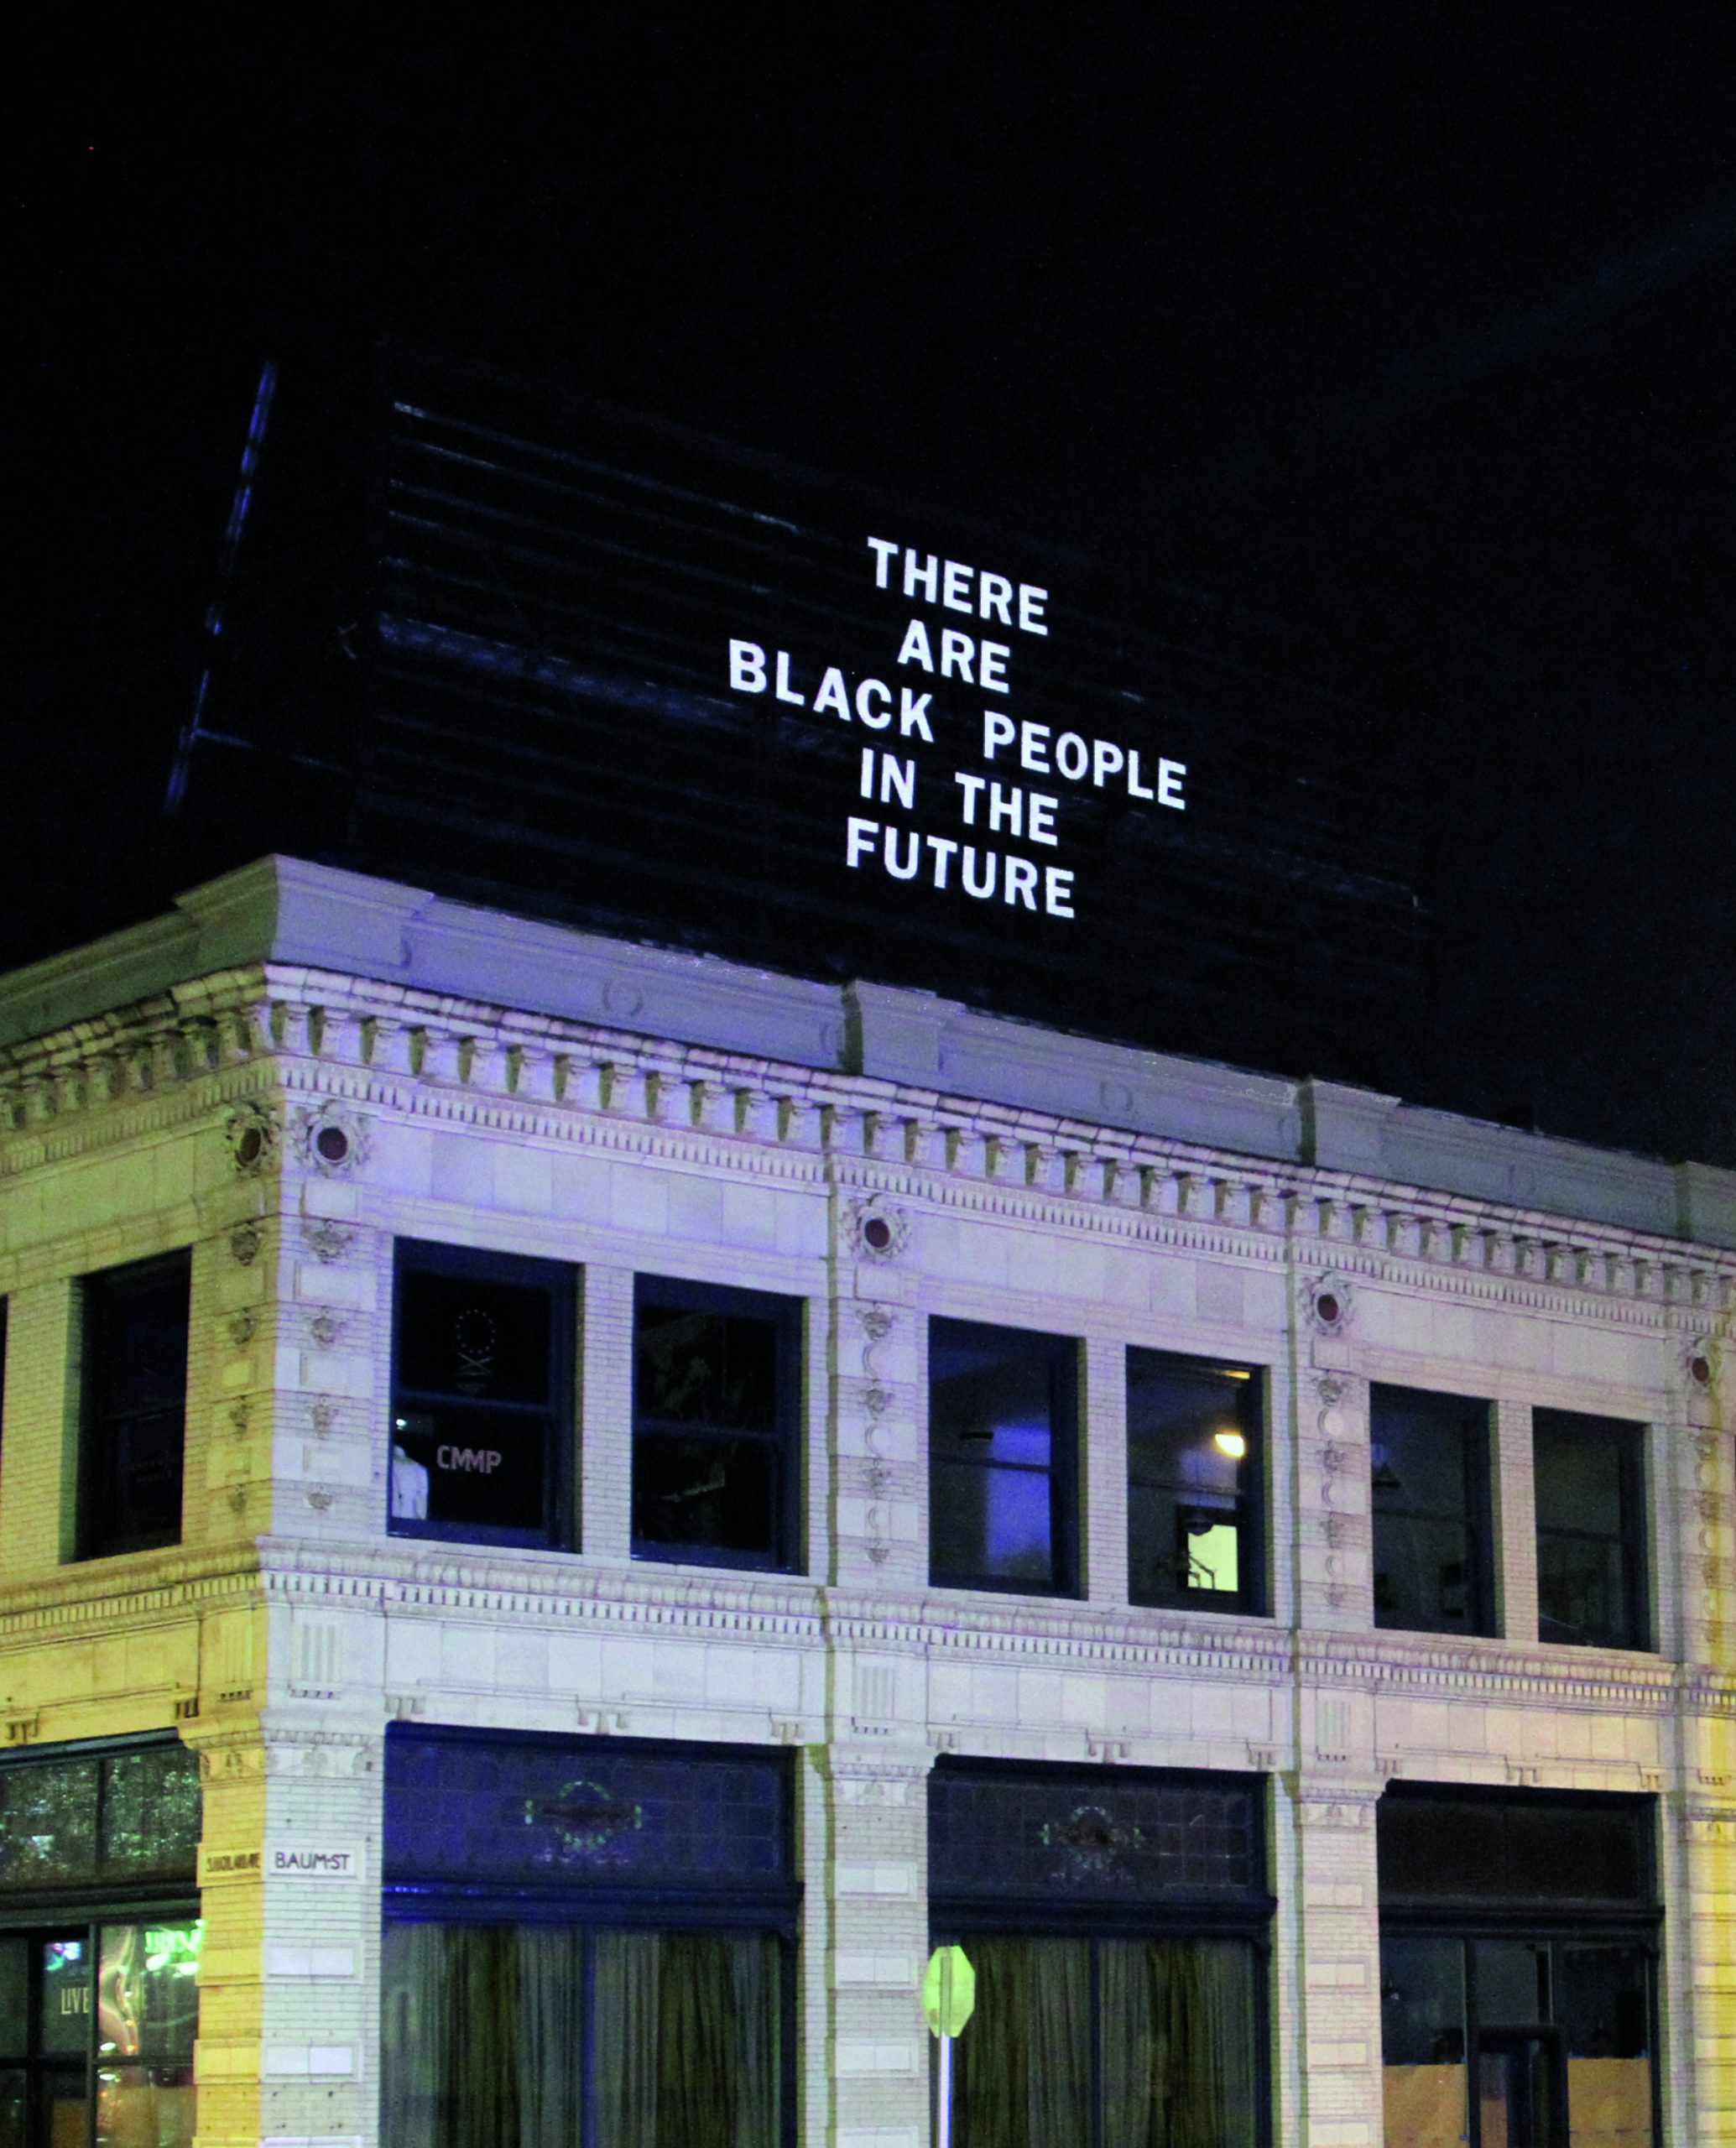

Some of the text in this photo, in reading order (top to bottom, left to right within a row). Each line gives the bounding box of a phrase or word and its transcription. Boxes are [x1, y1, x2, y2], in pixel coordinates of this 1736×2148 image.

[868, 536, 1048, 636] THERE
[897, 618, 1010, 694] ARE
[729, 639, 1186, 811] BLACK PEOPLE
[860, 747, 1059, 847] IN THE
[847, 816, 1075, 919] FUTURE
